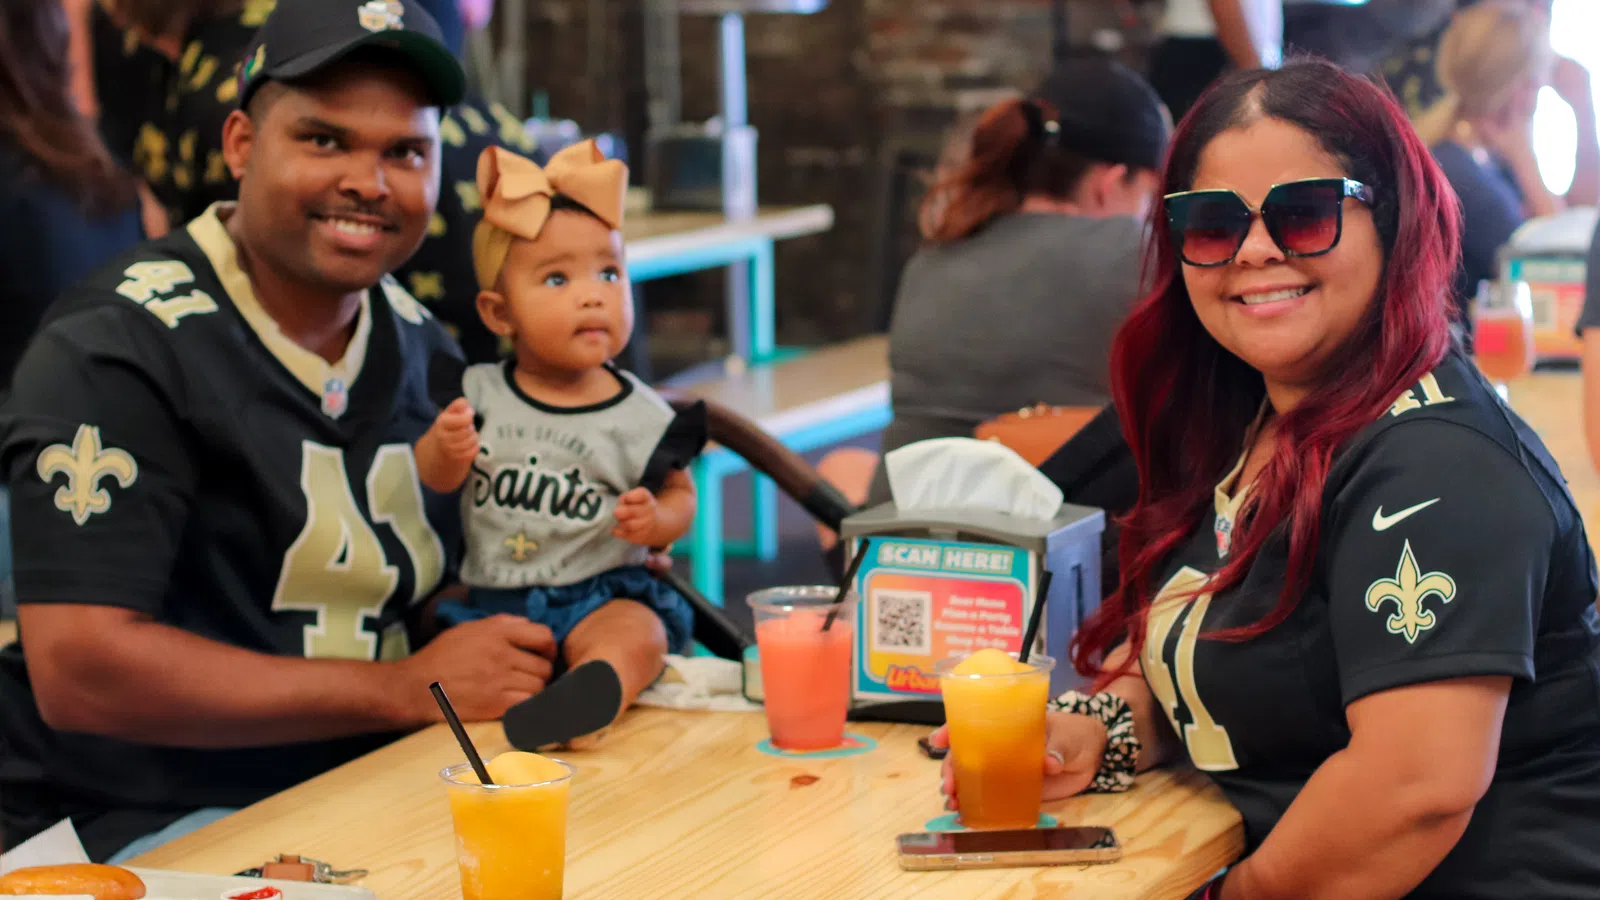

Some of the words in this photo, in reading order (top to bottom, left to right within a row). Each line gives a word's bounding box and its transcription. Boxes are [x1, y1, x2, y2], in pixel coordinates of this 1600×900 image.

[115, 260, 219, 328] 41
[472, 446, 602, 521] Saints
[272, 440, 445, 660] 41
[881, 546, 938, 566] SCAN
[945, 550, 1010, 570] HERE!
